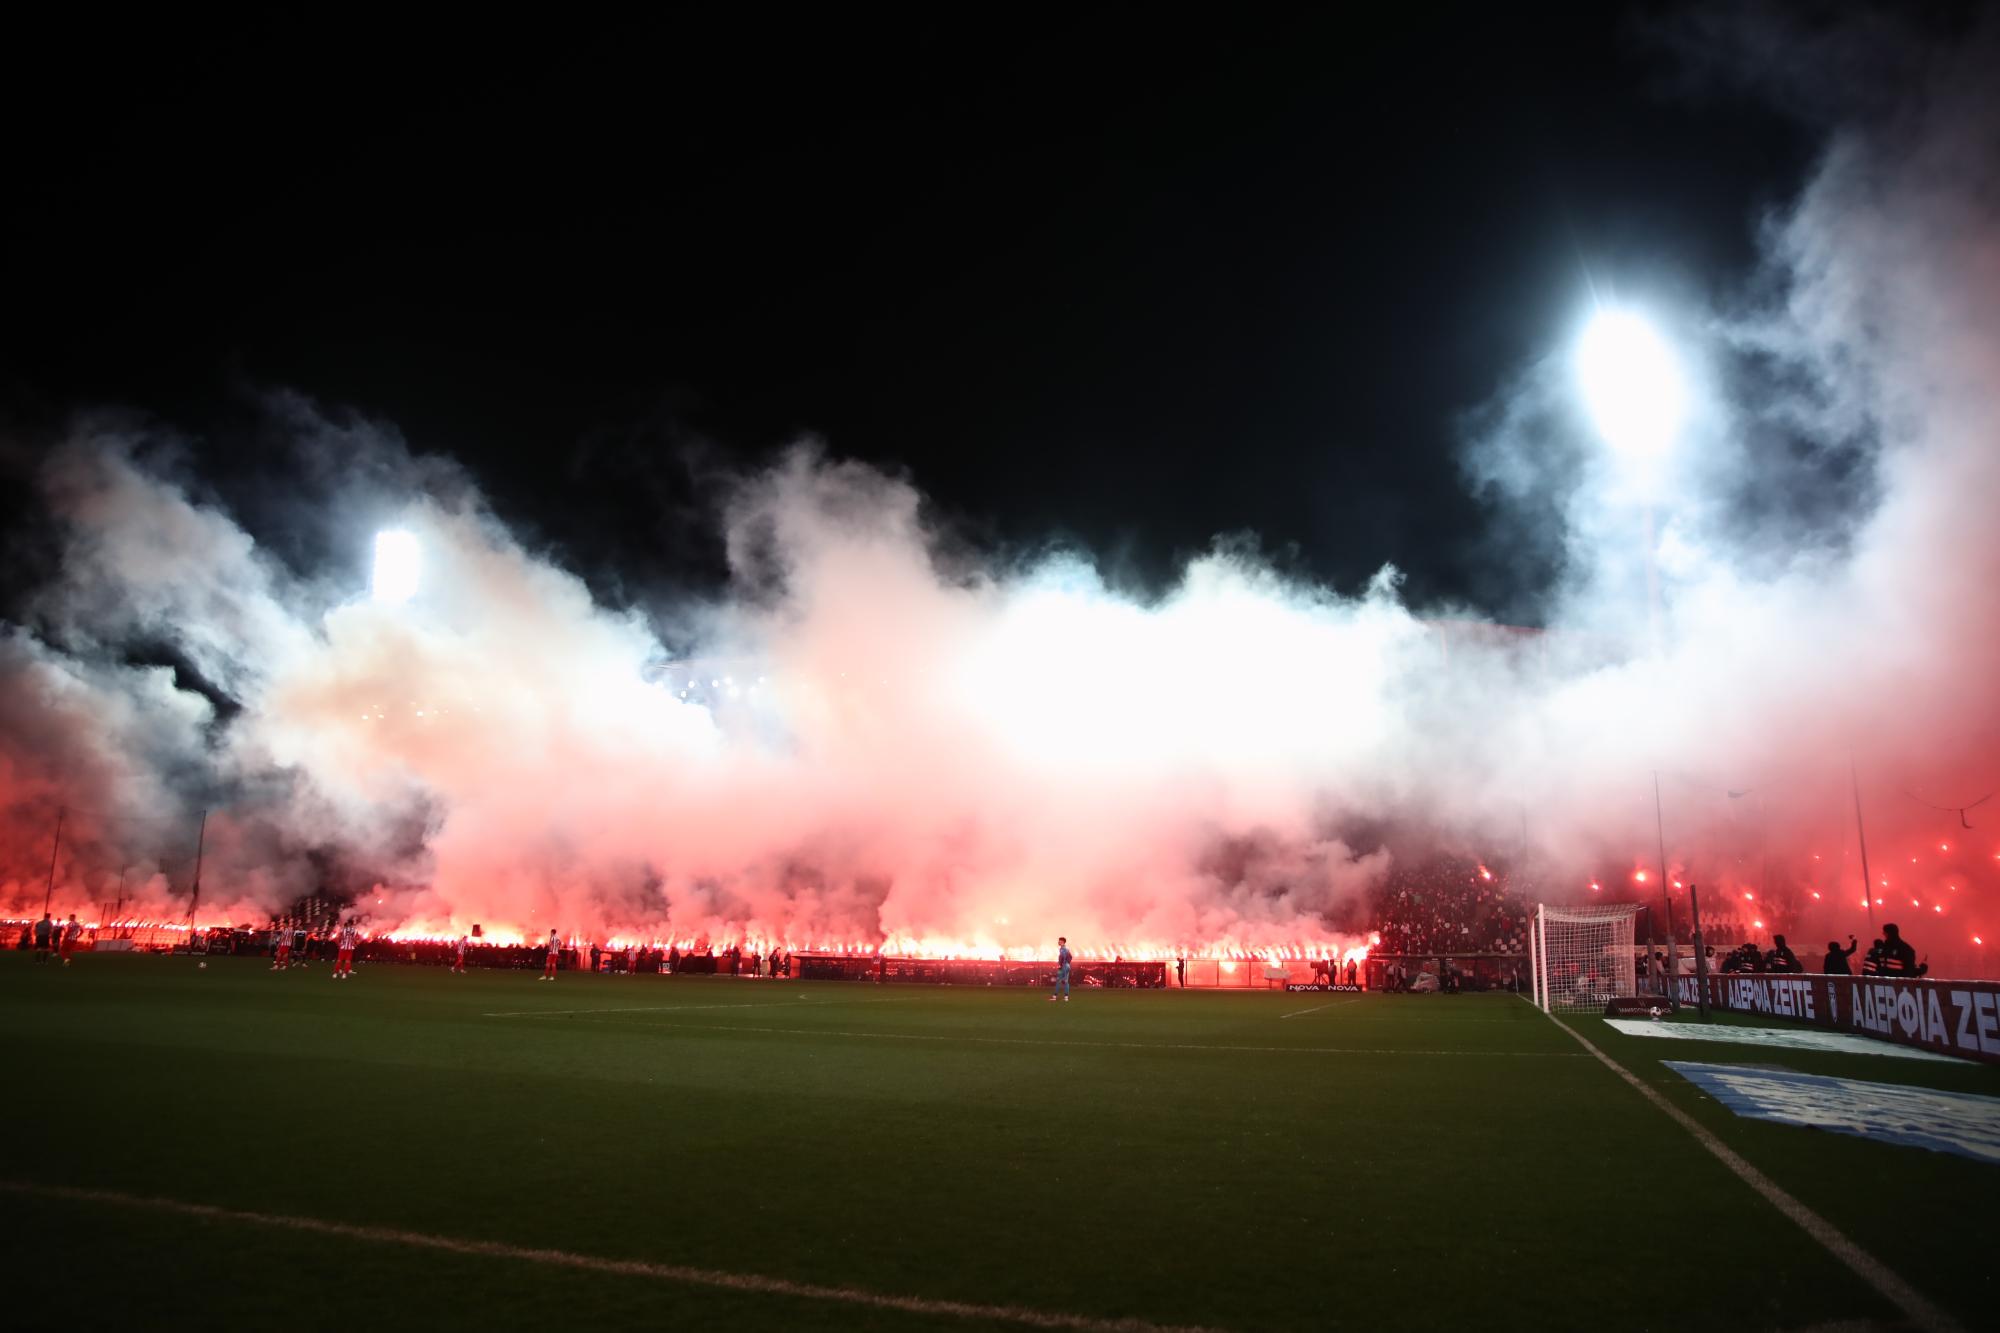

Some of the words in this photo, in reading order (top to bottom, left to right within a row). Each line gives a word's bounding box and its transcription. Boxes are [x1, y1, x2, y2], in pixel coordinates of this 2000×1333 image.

[1728, 979, 1772, 1013] ΑΔΕΡΦΙΑ
[1771, 979, 1815, 1019] ΖΕΙΤΕ
[1852, 983, 1950, 1045] ΑΔΕΡΦΙΑ
